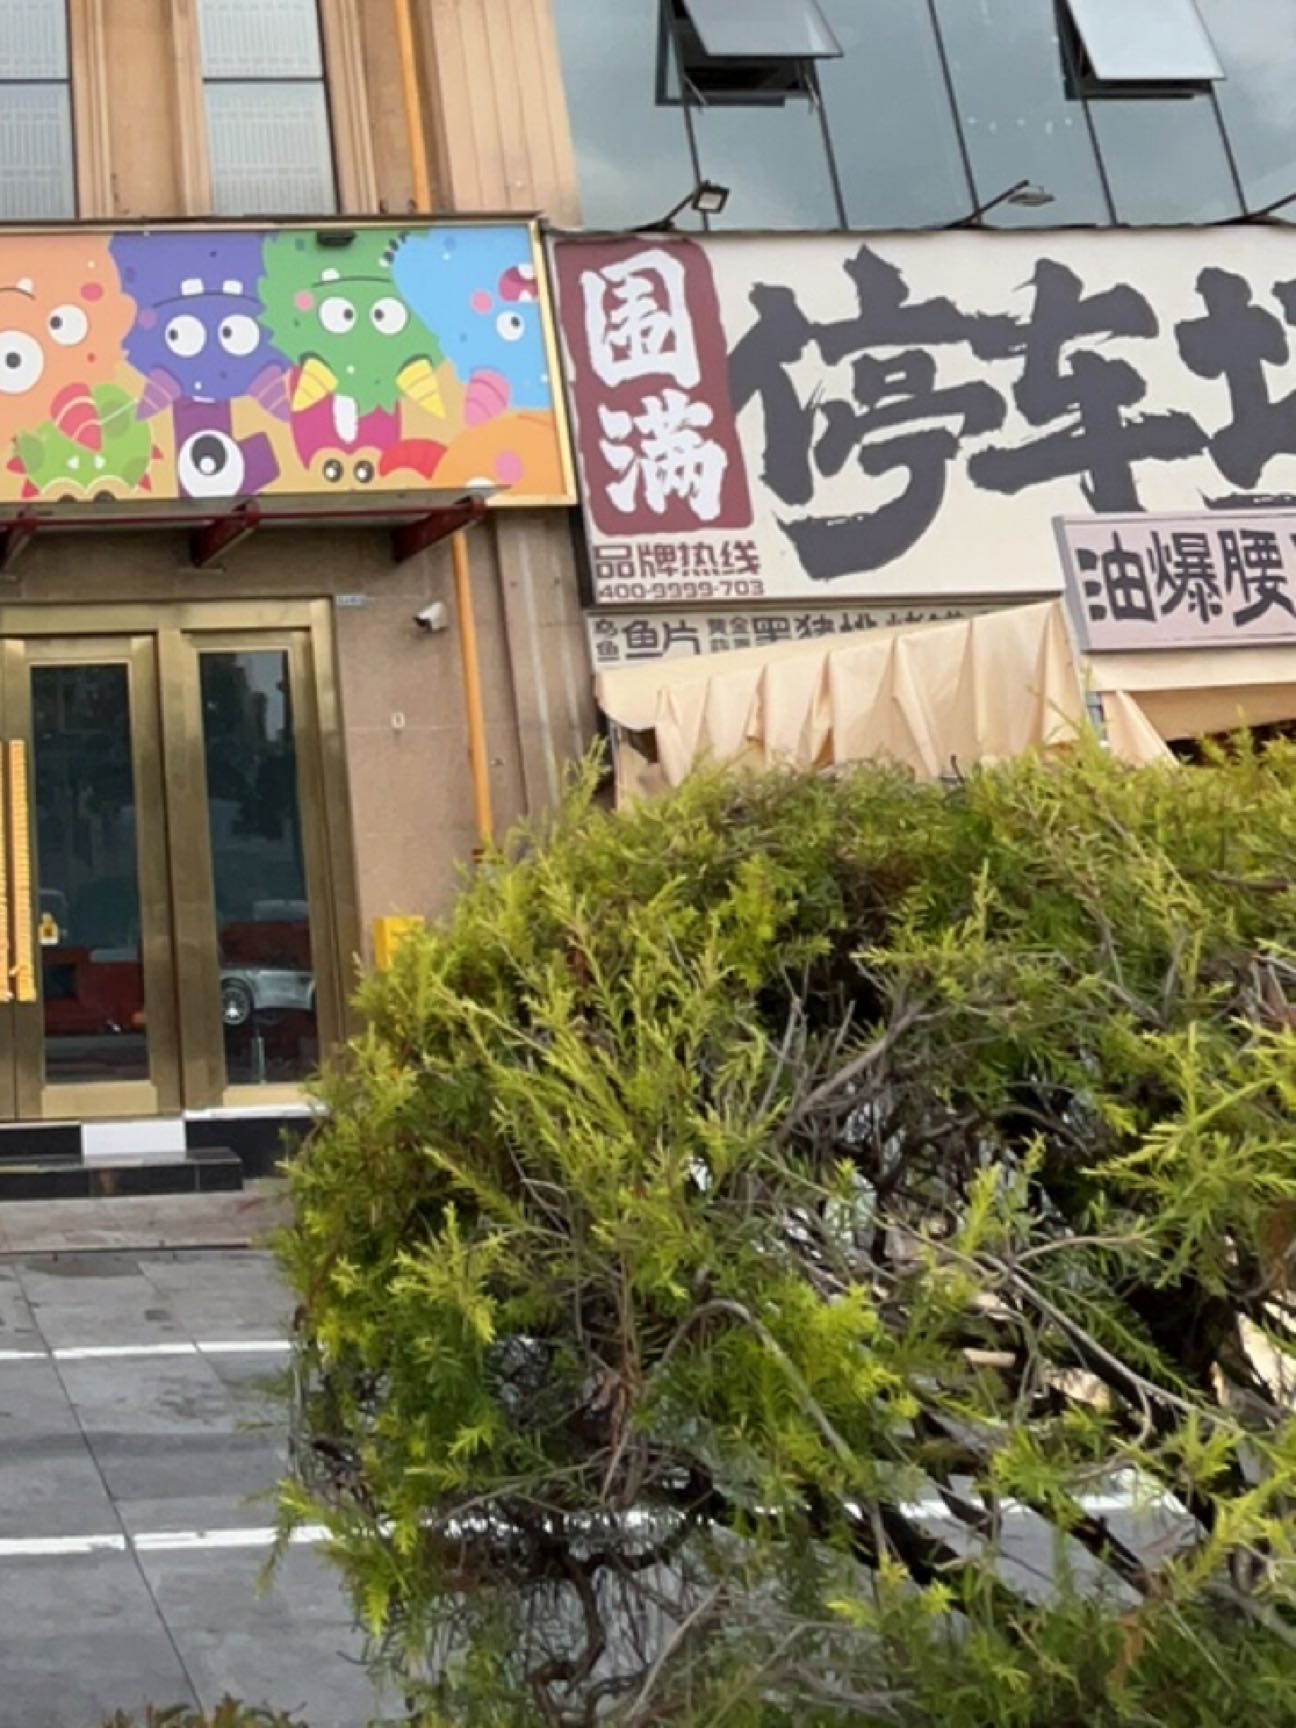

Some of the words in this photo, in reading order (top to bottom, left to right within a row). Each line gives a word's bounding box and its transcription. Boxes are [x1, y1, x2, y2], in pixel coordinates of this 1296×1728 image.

[593, 540, 762, 579] 品牌热线
[1075, 528, 1296, 628] 油爆腰
[597, 580, 765, 600] 400-9999-703
